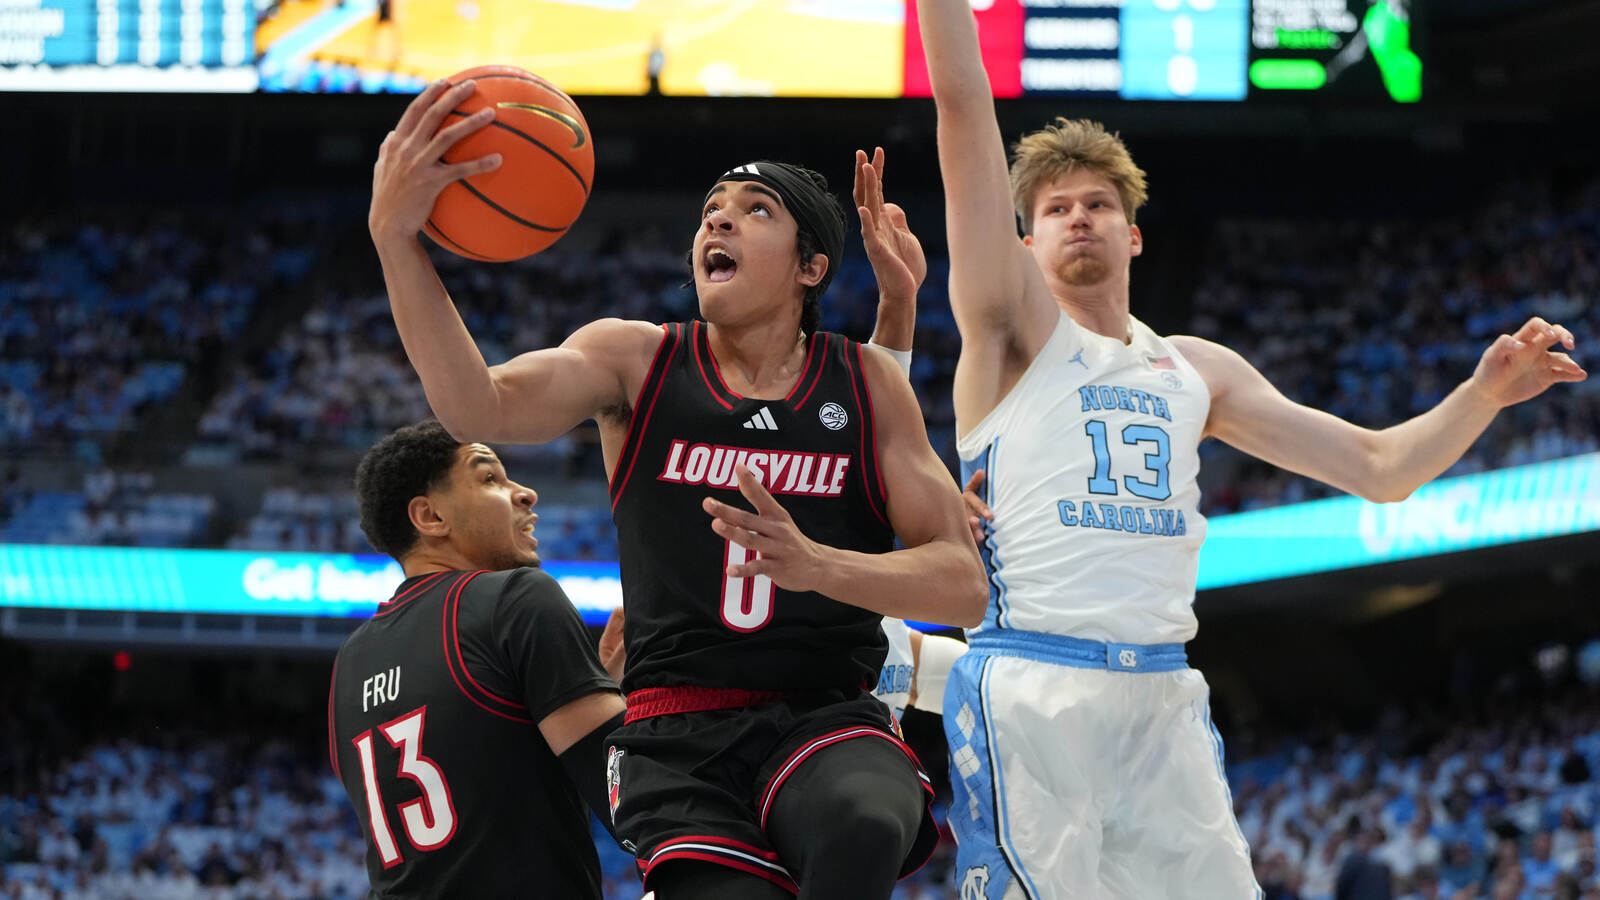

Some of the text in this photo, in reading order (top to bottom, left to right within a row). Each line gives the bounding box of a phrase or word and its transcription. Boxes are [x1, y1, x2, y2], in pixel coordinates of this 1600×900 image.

[1079, 385, 1172, 422] NORTH
[657, 440, 851, 497] LOUISVILLE
[1085, 419, 1172, 502] 13
[1057, 500, 1186, 537] CAROLINA
[363, 666, 401, 712] FRU
[352, 705, 458, 869] 13
